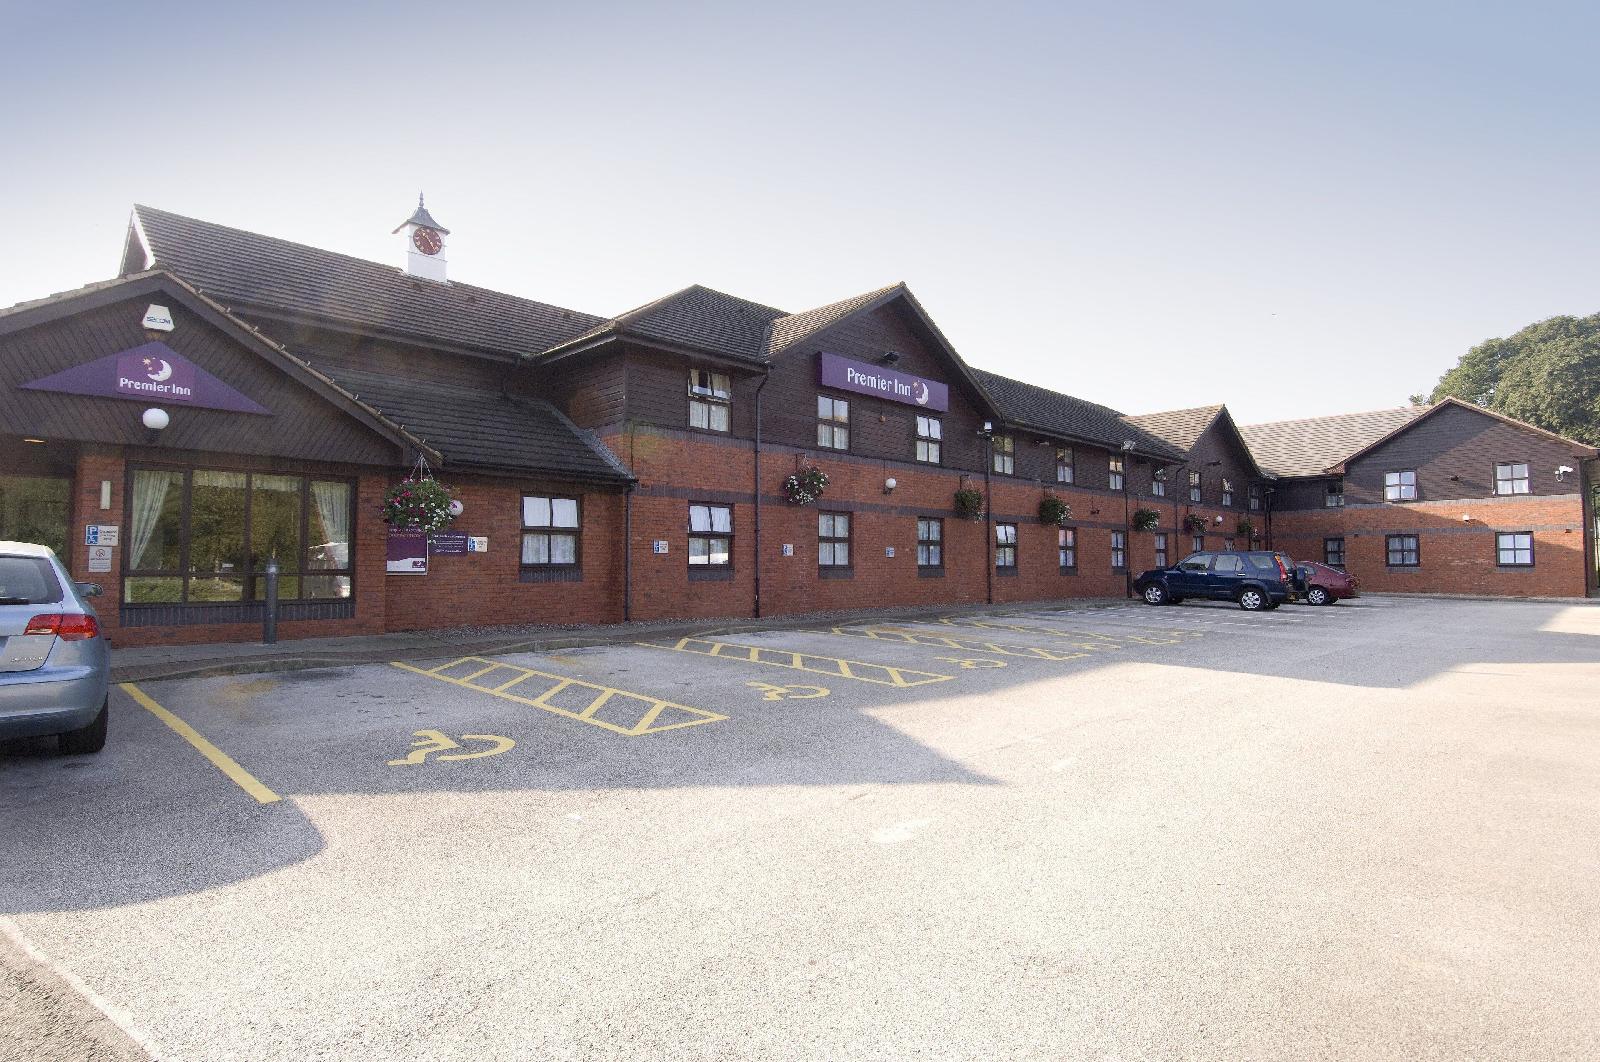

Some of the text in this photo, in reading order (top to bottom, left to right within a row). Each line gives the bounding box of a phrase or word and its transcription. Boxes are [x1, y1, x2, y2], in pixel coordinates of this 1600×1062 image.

[119, 377, 191, 396] Premier Inn
[847, 367, 911, 397] Premier Inn
